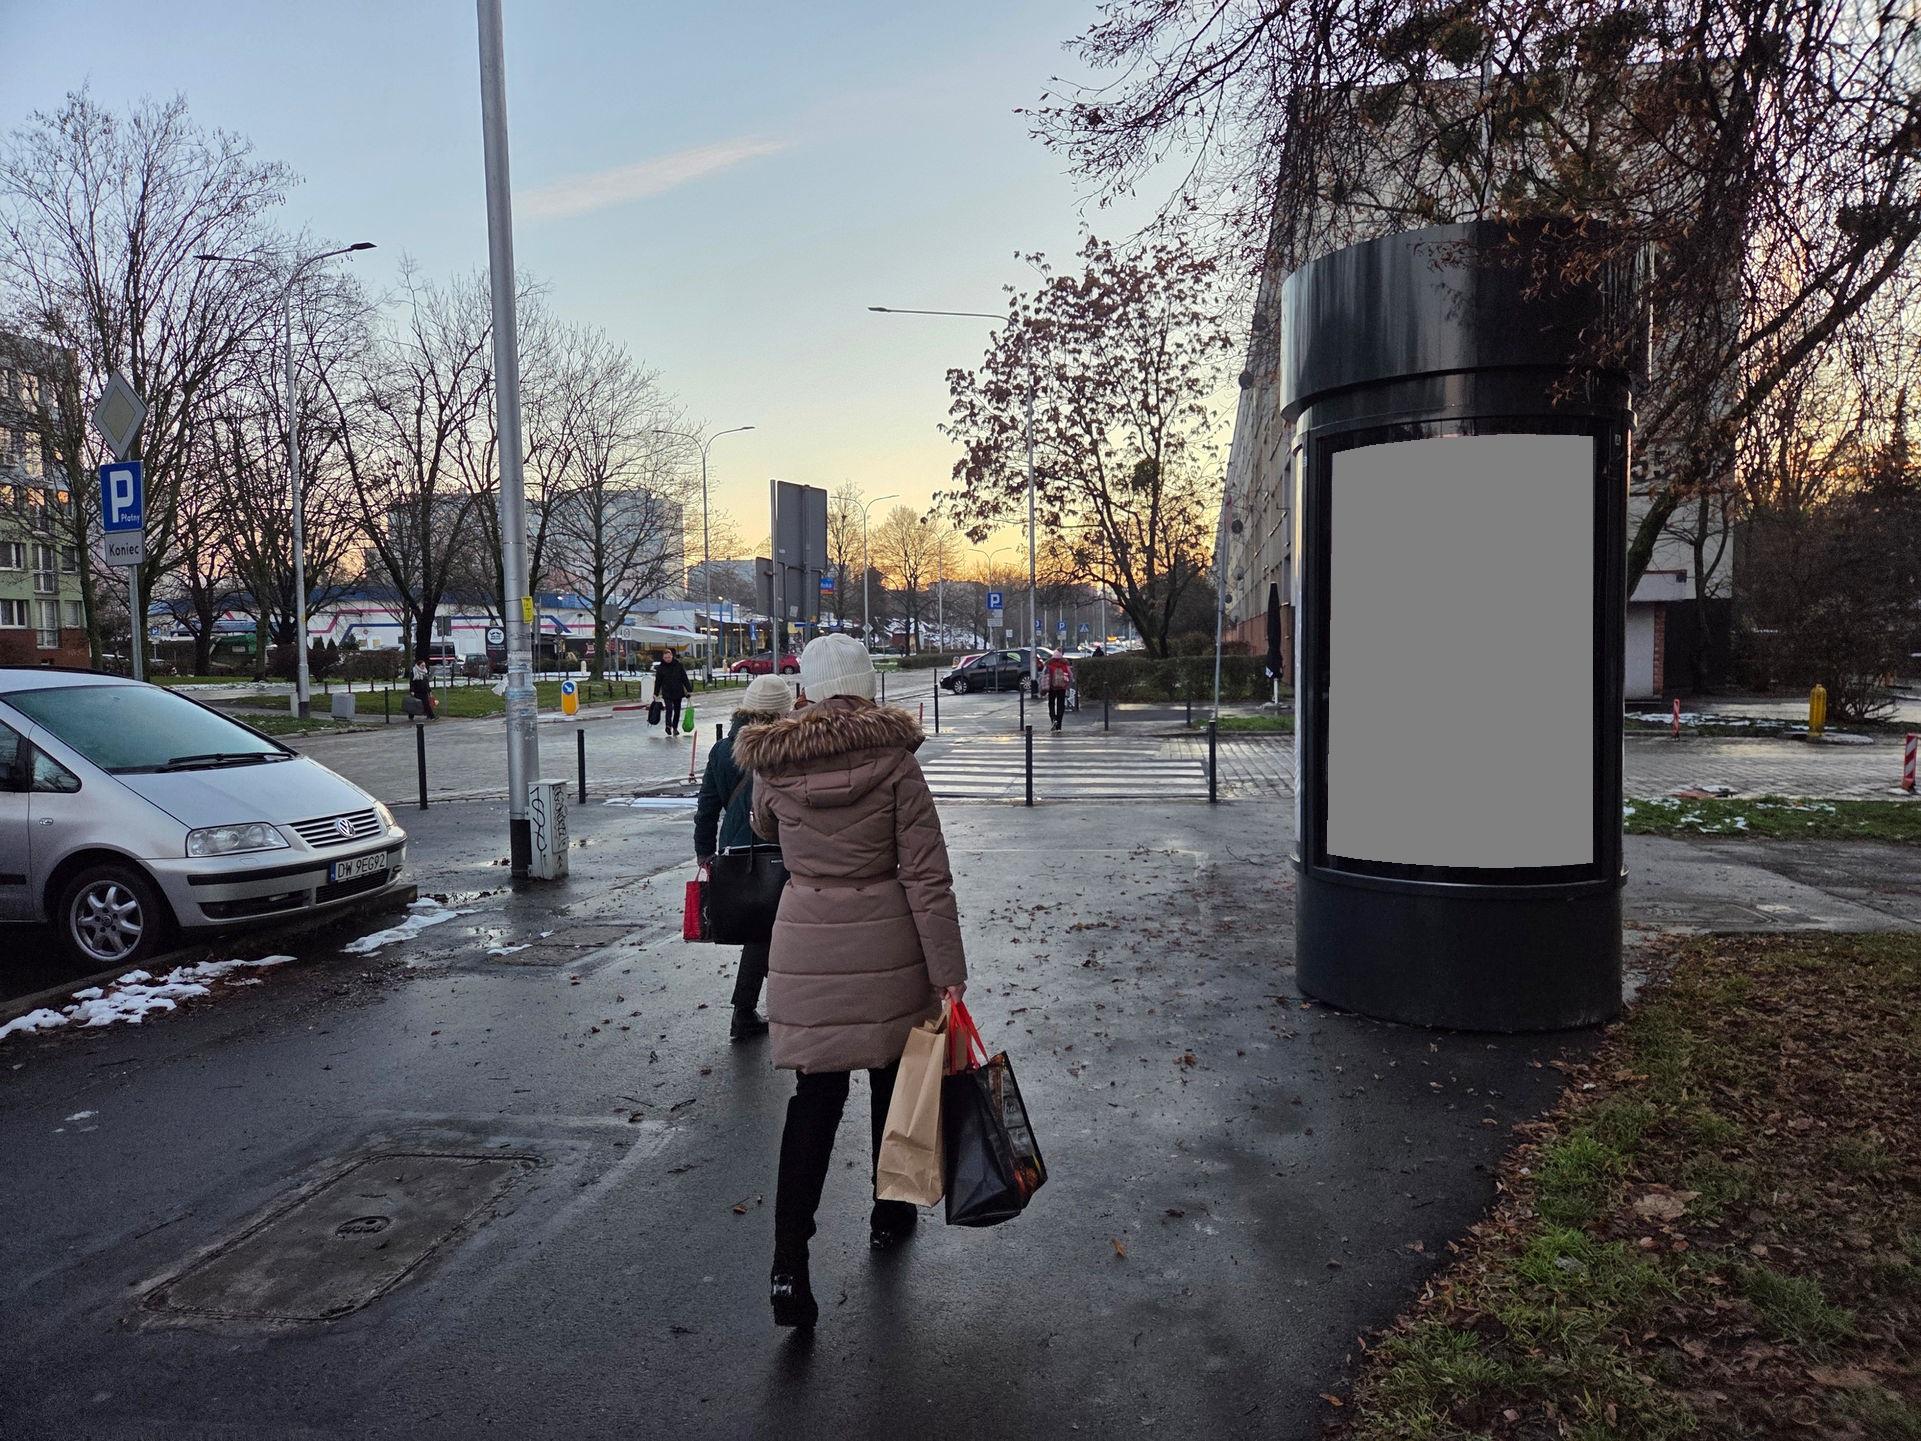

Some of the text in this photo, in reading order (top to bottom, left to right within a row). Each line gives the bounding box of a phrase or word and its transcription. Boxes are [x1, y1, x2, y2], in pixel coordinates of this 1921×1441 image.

[110, 470, 134, 523] P
[121, 513, 140, 524] Płatny
[109, 543, 139, 557] Koniec
[991, 593, 1000, 608] P
[1059, 622, 1065, 630] P
[337, 853, 385, 878] DW 9EG92
